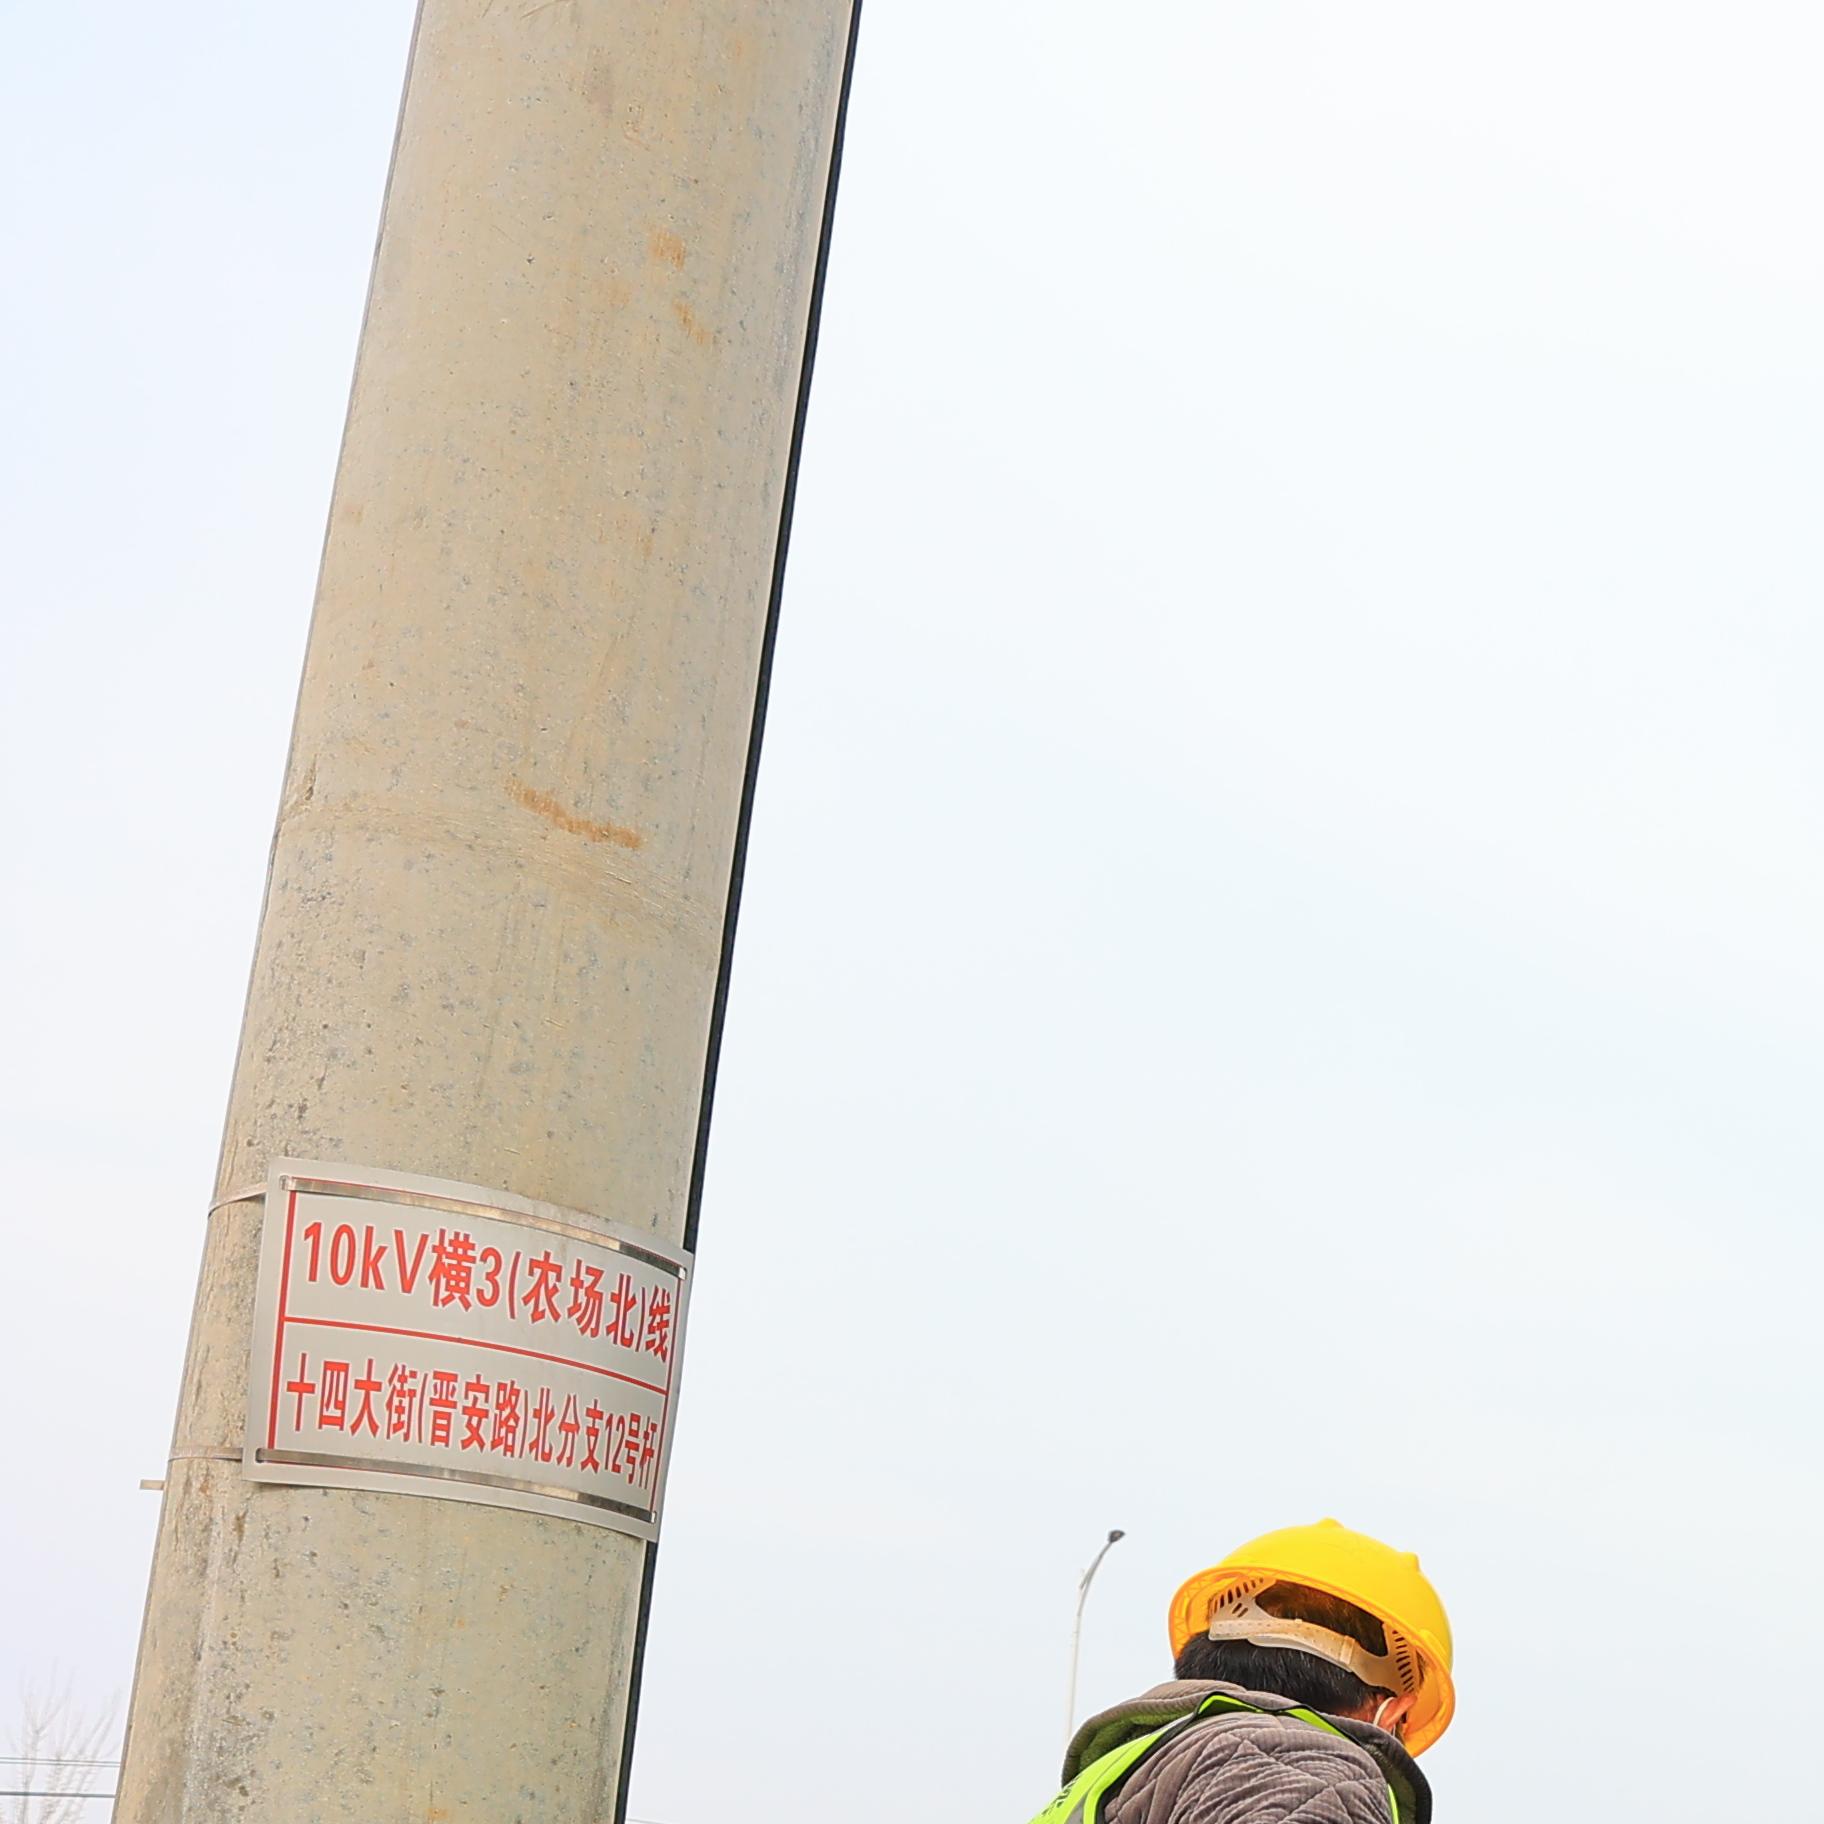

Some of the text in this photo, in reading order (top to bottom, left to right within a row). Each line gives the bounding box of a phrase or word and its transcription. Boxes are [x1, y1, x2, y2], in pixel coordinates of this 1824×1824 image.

[303, 1222, 673, 1364] 10kV横3(农场北)线
[286, 1353, 657, 1491] 十四大街(晋安路)北分支12号杆
